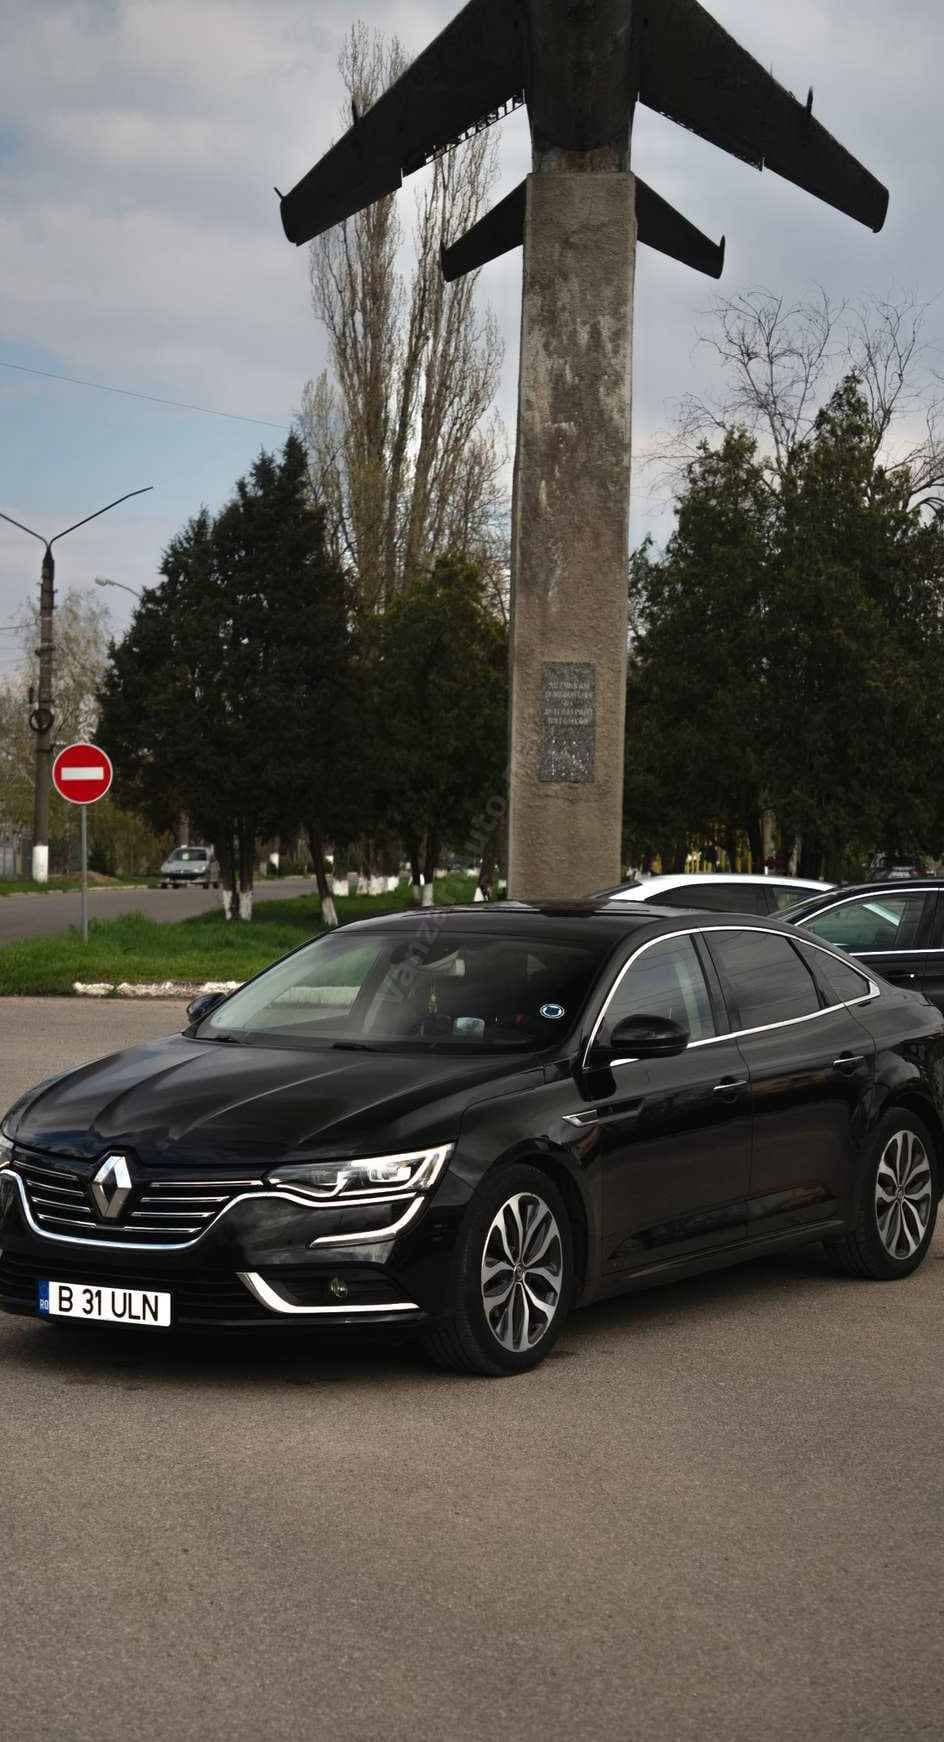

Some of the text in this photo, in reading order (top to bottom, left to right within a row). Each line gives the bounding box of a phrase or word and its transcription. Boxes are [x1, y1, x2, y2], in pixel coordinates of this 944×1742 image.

[39, 1299, 49, 1310] RO
[58, 1286, 159, 1322] B 31 ULN
